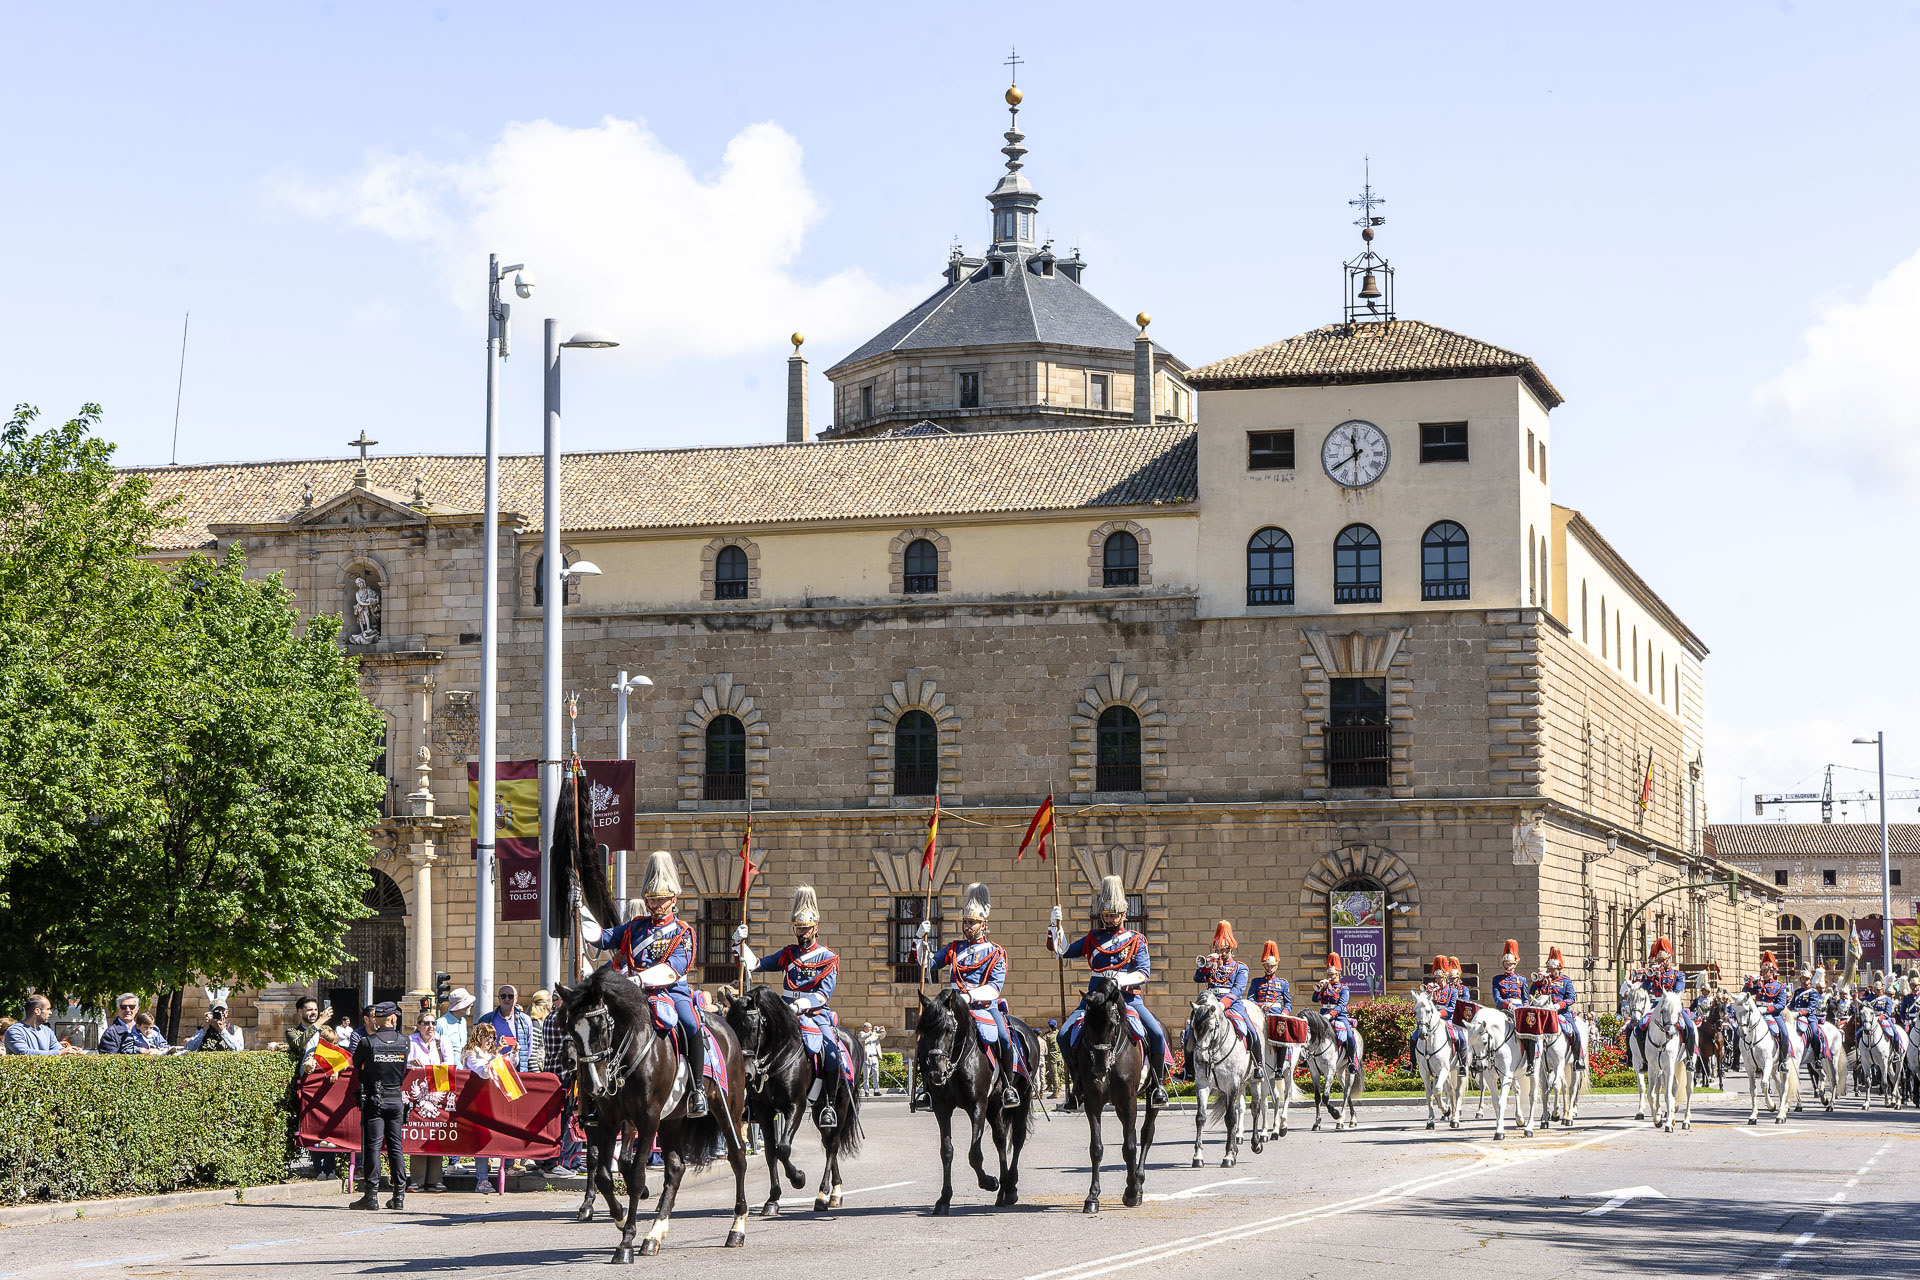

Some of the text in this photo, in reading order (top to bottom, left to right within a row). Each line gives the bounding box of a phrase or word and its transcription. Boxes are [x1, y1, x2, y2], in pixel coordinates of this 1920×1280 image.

[593, 815, 620, 828] LEDO
[509, 892, 538, 901] TOLEDO
[1340, 939, 1377, 961] Imago
[1343, 958, 1376, 980] Regis
[401, 1128, 458, 1141] TOLEDO
